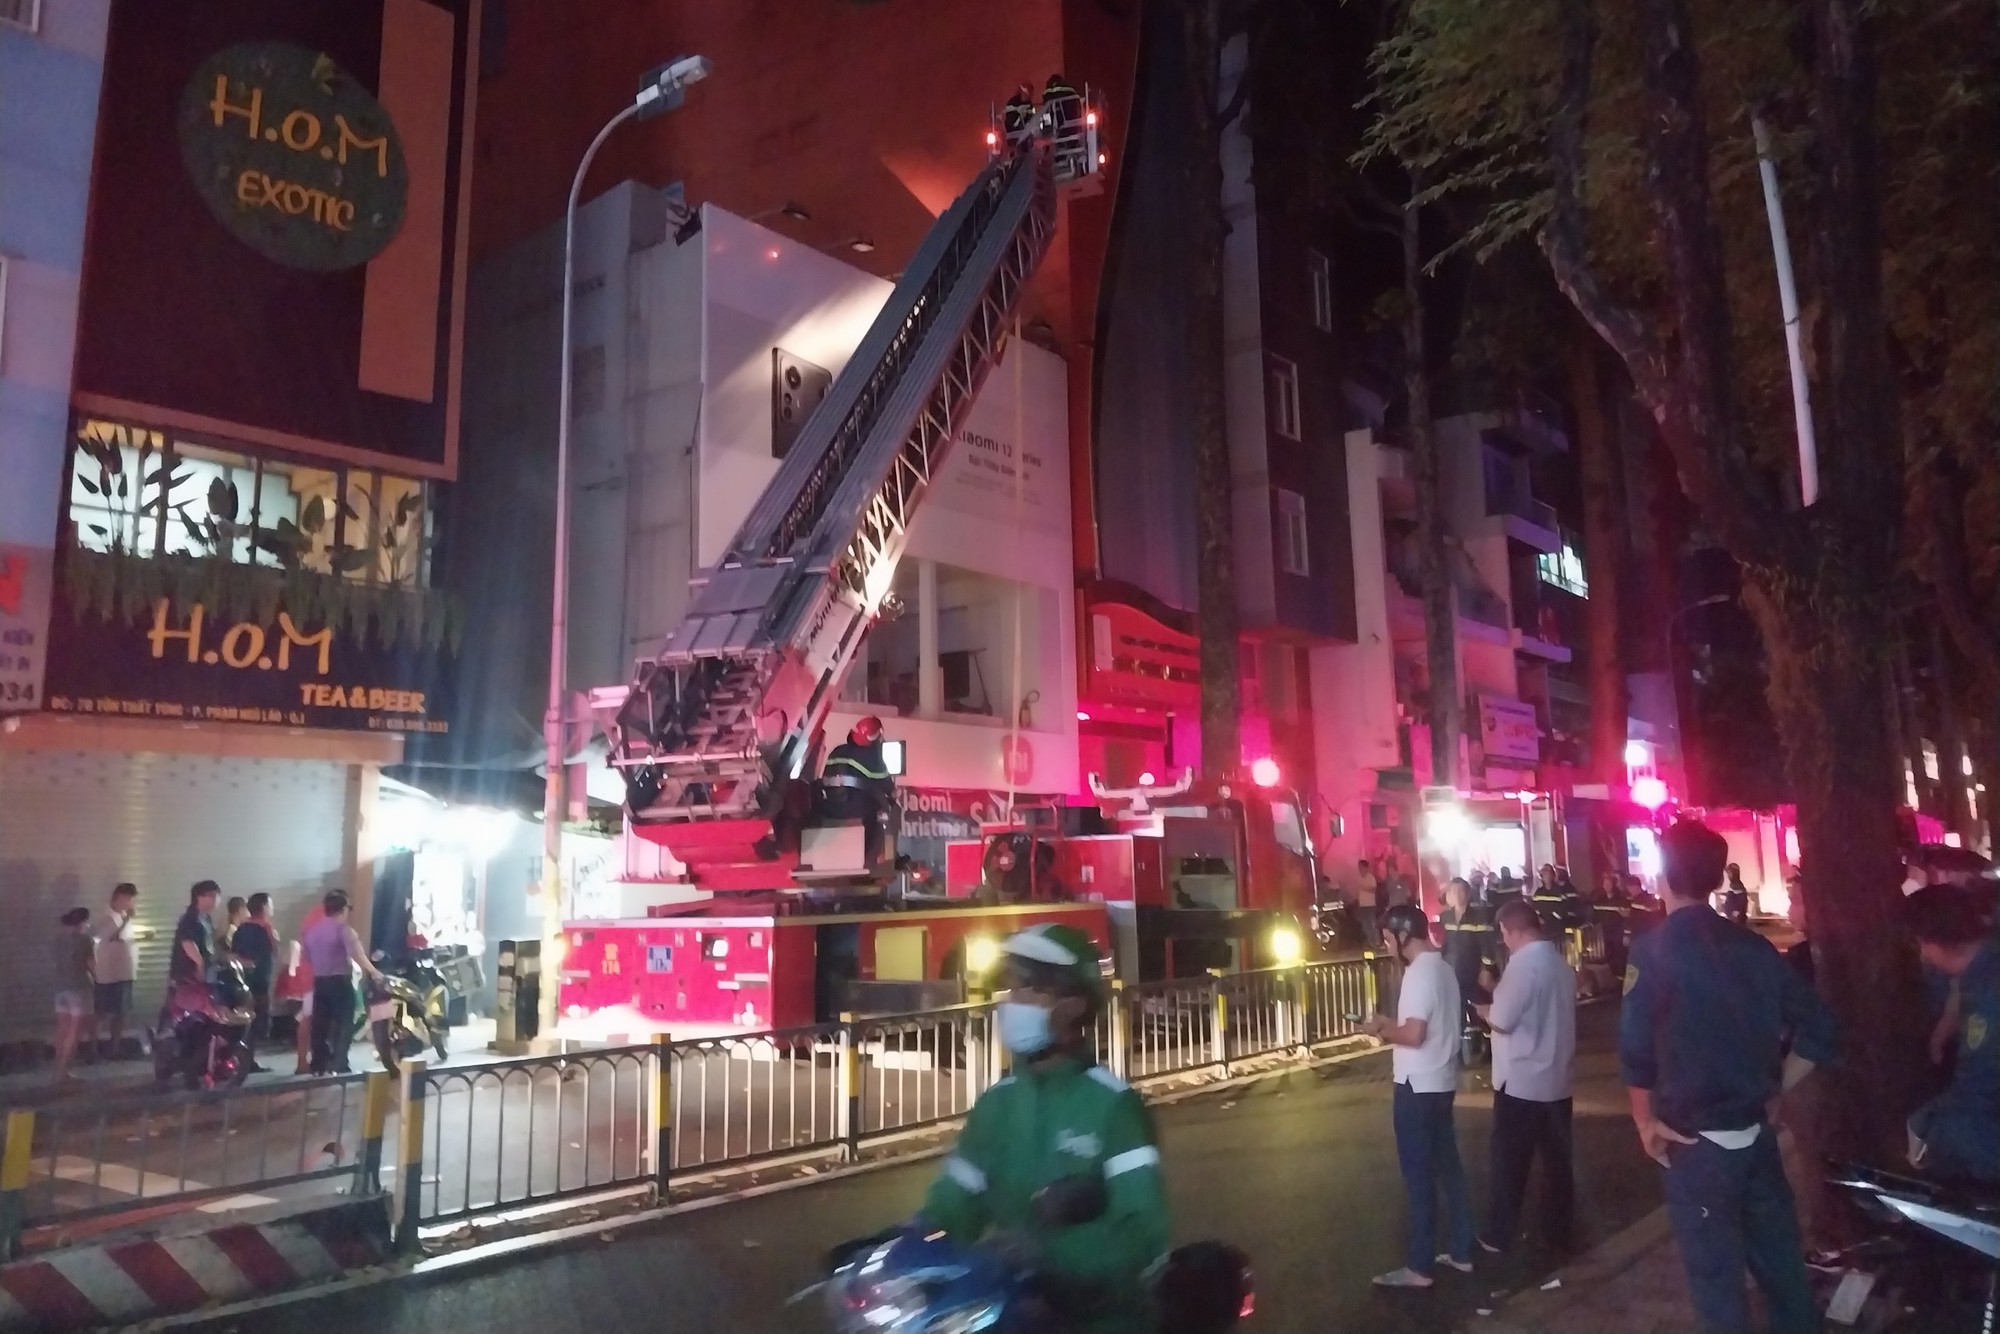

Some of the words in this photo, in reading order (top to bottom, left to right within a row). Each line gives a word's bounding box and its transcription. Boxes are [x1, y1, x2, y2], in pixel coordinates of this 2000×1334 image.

[238, 170, 354, 231] EXOTIC
[958, 430, 999, 453] iaomi
[1002, 443, 1012, 458] 12
[900, 809, 968, 837] hristmas
